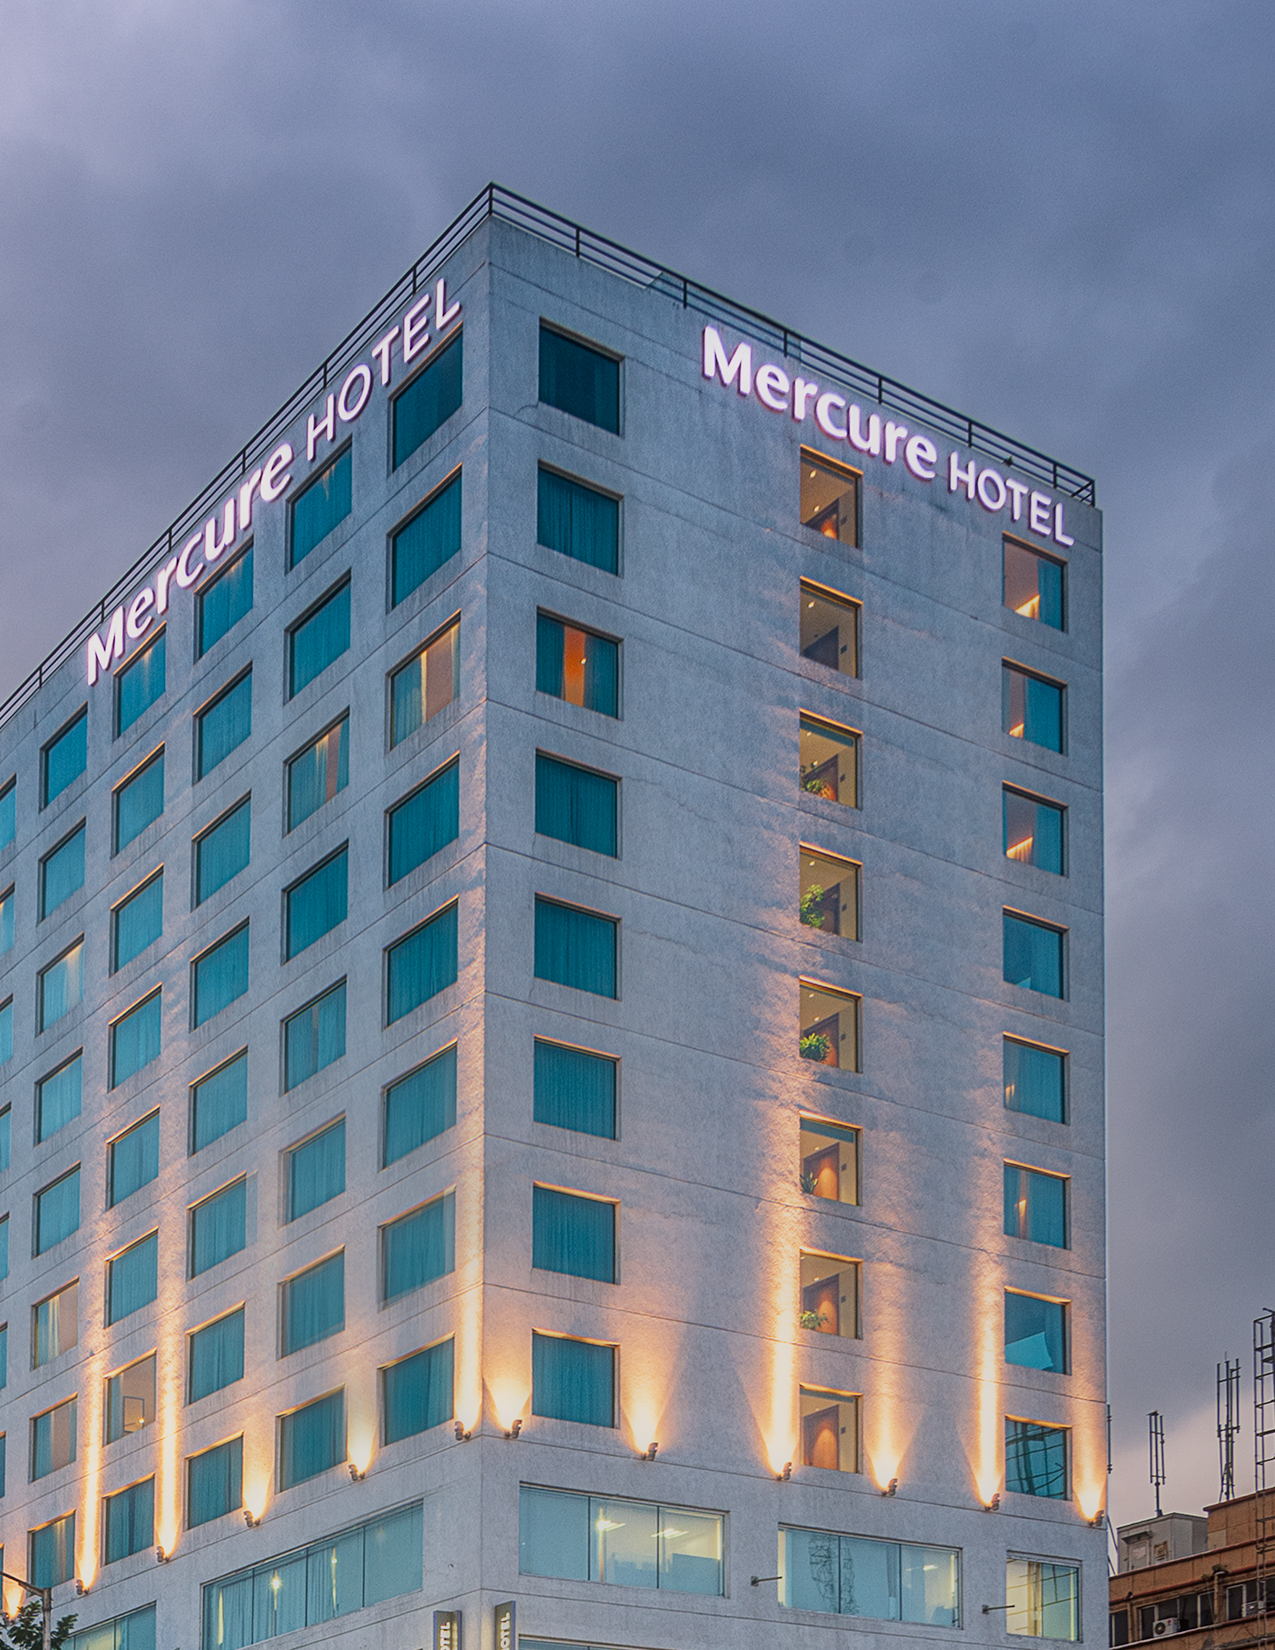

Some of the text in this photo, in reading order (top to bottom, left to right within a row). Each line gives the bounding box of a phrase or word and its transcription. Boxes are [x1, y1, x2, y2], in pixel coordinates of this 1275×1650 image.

[85, 277, 462, 686] Mercure HOTEL
[702, 324, 1076, 547] Mercure HOTEL
